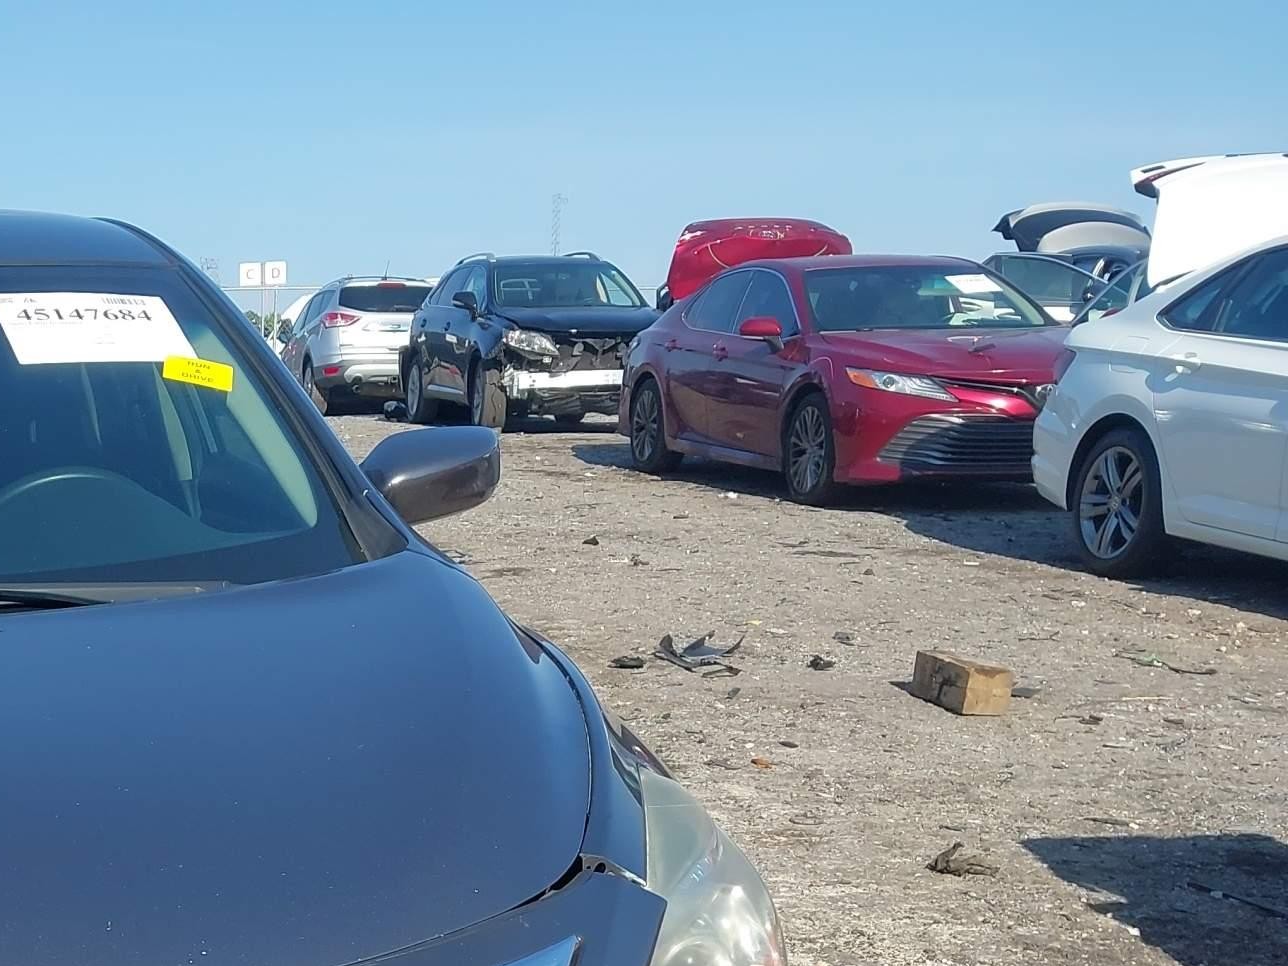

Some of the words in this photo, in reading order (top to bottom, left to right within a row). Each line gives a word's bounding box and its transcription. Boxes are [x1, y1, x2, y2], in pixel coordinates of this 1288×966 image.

[246, 269, 255, 279] C
[271, 267, 281, 279] D
[16, 307, 153, 321] 45147684
